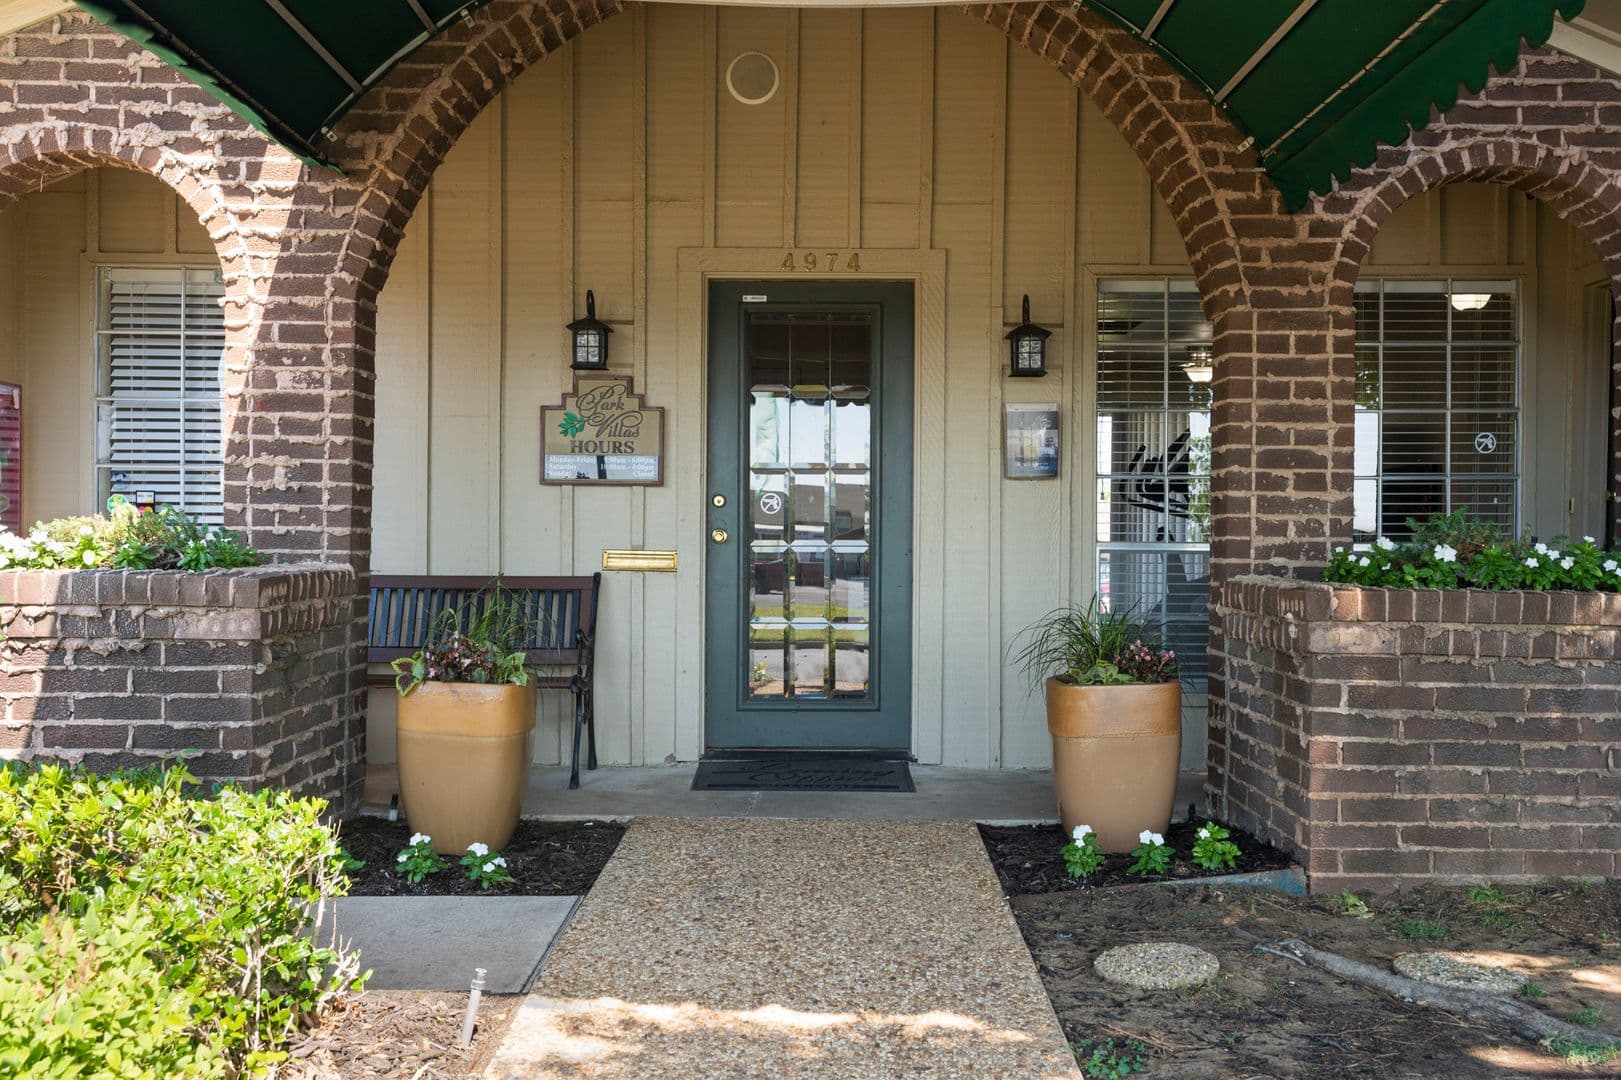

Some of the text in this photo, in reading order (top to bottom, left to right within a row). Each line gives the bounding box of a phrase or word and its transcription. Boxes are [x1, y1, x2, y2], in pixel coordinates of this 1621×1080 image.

[781, 252, 862, 272] 4974
[576, 384, 627, 418] Park
[587, 410, 644, 438] Villas
[570, 440, 635, 454] HOURS
